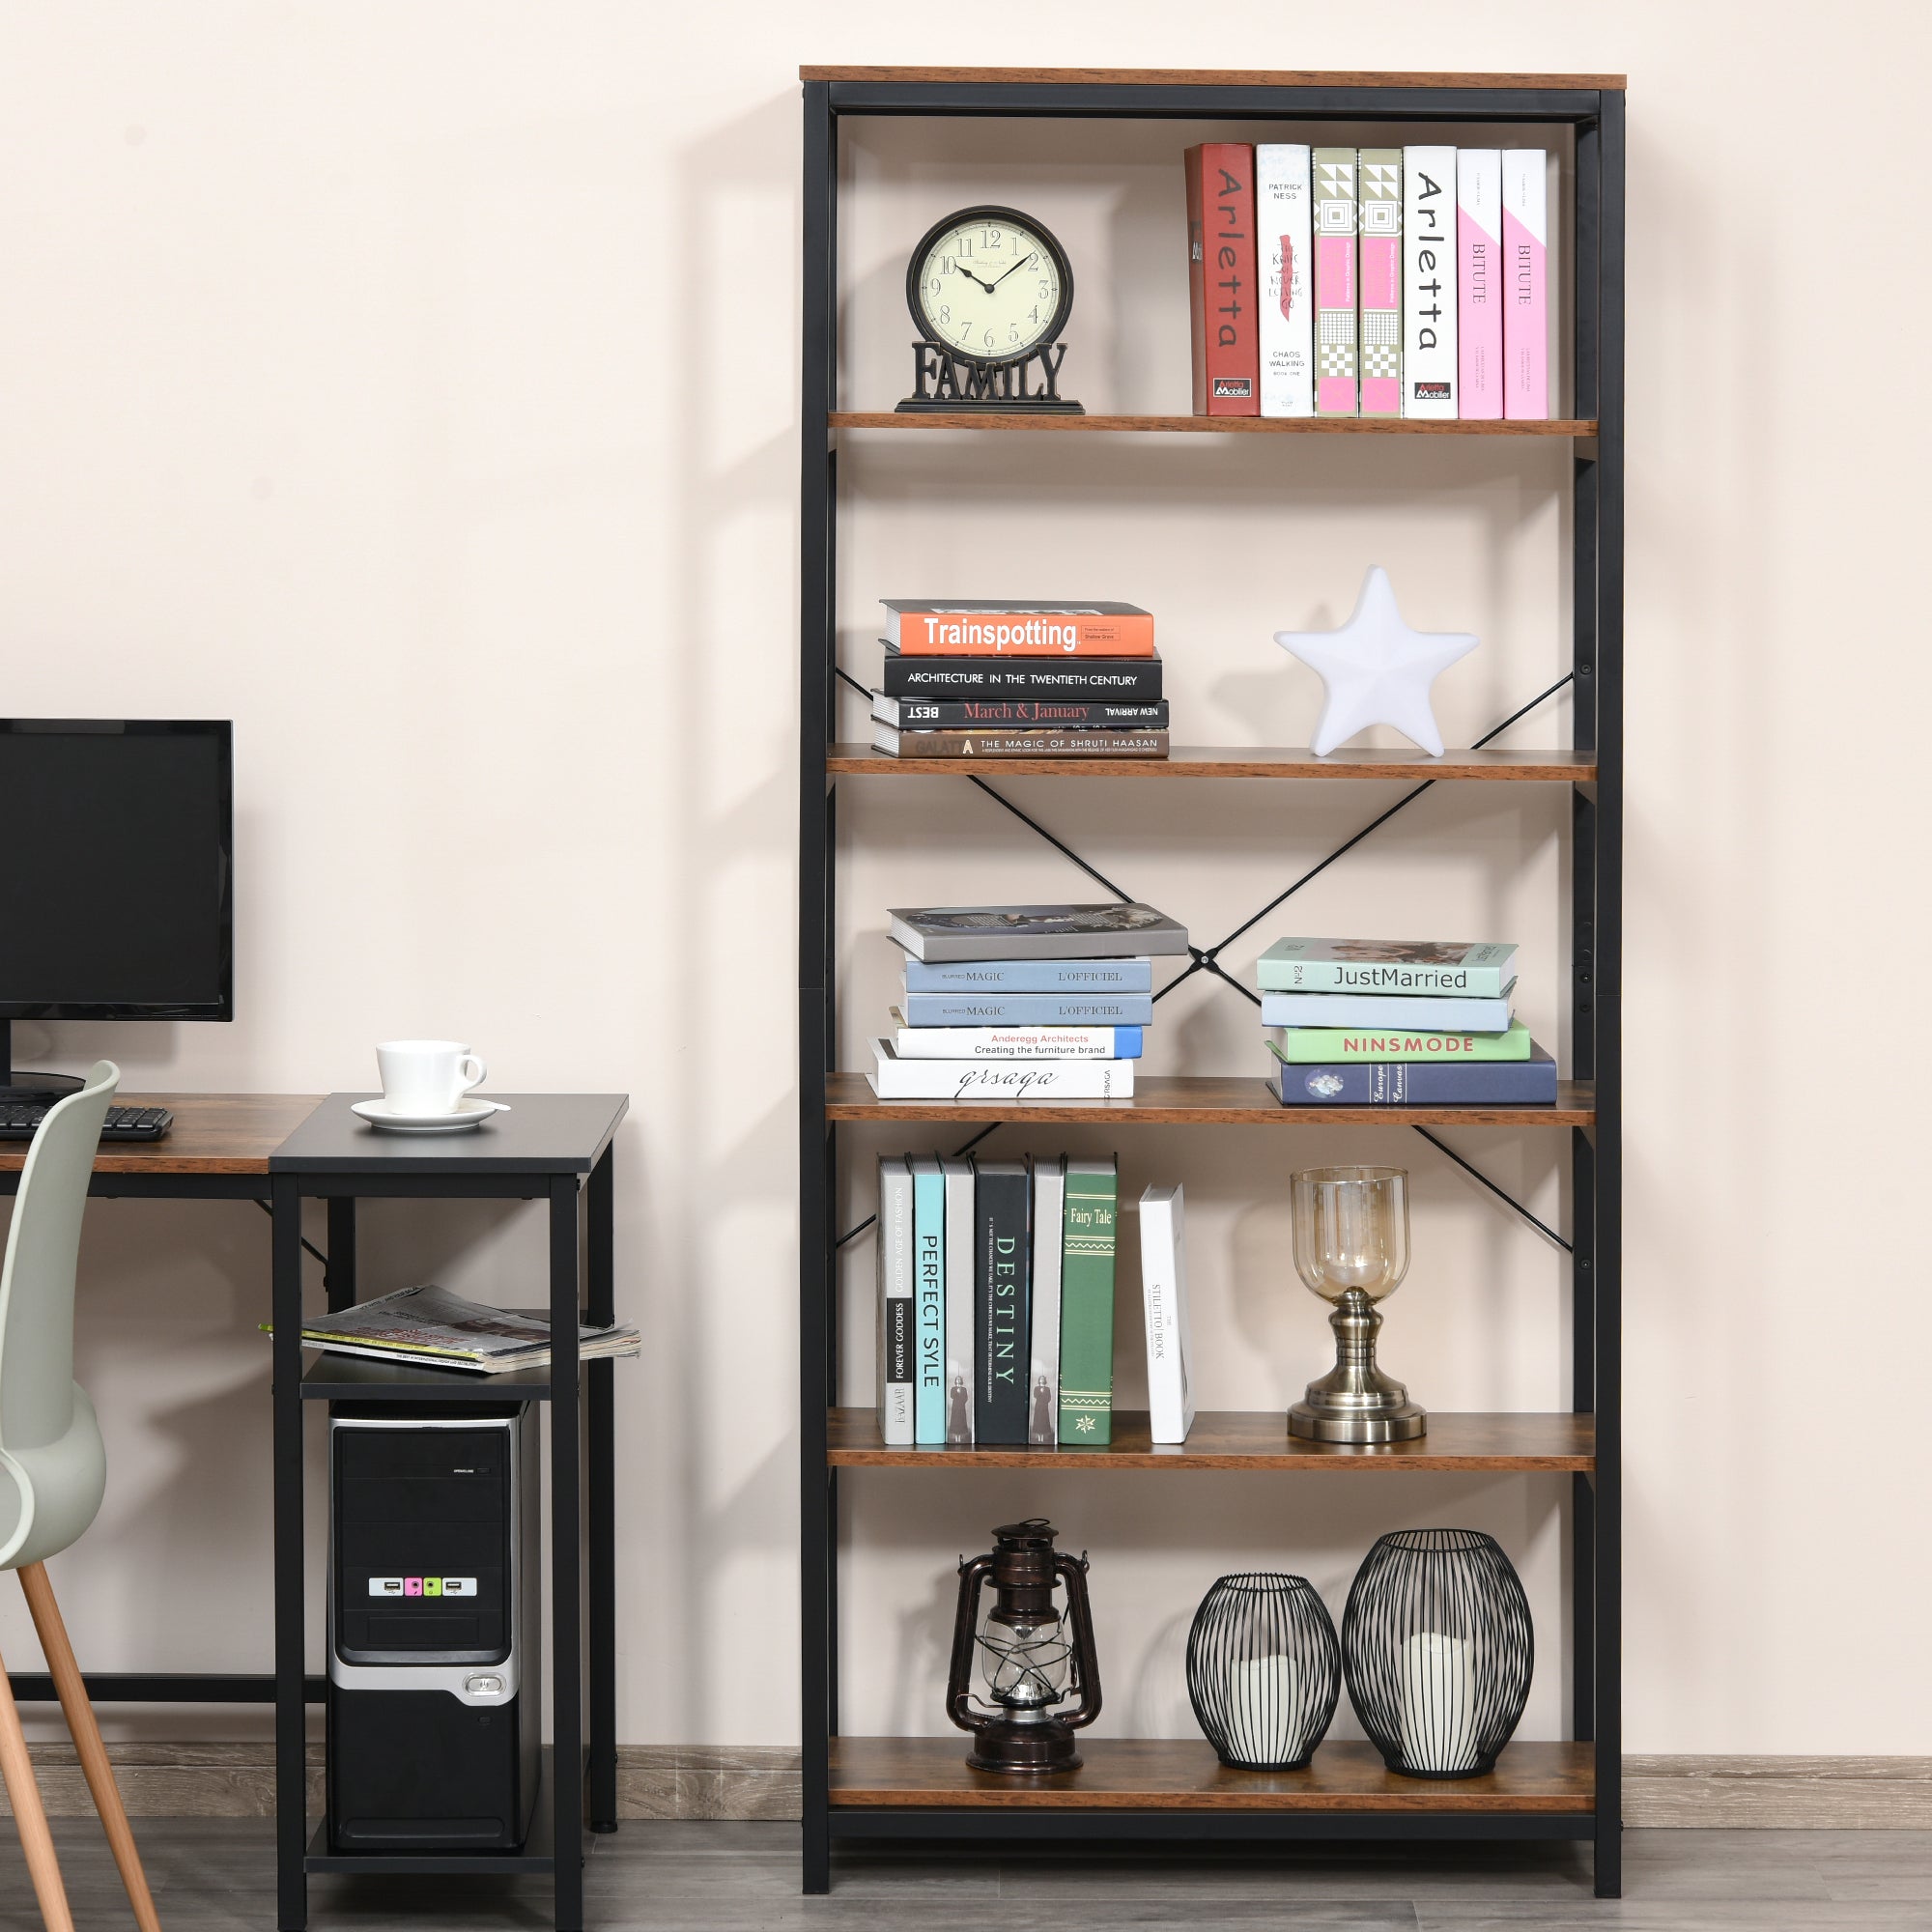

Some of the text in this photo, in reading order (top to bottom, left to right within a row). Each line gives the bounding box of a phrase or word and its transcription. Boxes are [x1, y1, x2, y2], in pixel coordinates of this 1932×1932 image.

[955, 238, 974, 258] 11
[980, 229, 1001, 249] 12
[1011, 237, 1019, 256] 1
[939, 255, 956, 275] 10
[1027, 252, 1038, 272] 2
[1218, 169, 1244, 347] Arletta
[1418, 172, 1444, 350] Arletta
[1472, 243, 1486, 304] BITUTE
[1518, 243, 1532, 305] BITUTE
[930, 277, 941, 298] 9
[1038, 279, 1049, 299] 3
[939, 304, 951, 325] 8
[1027, 304, 1038, 325] 4
[960, 322, 973, 341] 7
[983, 327, 995, 348] 6
[1009, 323, 1018, 342] 5
[912, 341, 1068, 400] FAMILY
[923, 617, 1077, 652] Trainspotting
[907, 672, 1138, 686] ARCHITECTURE IN THE TWENTIETH CENTURY
[907, 706, 939, 719] BEST
[964, 703, 1090, 722] March & January
[1105, 707, 1158, 717] NEW ARRIVAL
[1112, 739, 1157, 748] HAASAN
[966, 972, 1005, 981] MAGIC
[1058, 972, 1122, 981] L'OFFICIEL
[1333, 966, 1467, 989] JustMarried
[966, 1006, 1006, 1015] MAGIC
[1059, 1006, 1123, 1015] L'OFFICIEL
[991, 1035, 1089, 1044] Anderegg Architects
[1344, 1037, 1474, 1052] NINSMODE
[975, 1045, 1106, 1056] Creating the furniture brand
[1373, 1065, 1387, 1102] Europe
[1392, 1065, 1403, 1102] Canvas
[1070, 1208, 1112, 1227] Fairy Tale
[895, 1187, 903, 1293] GOLDEN AGE OF FASHION
[923, 1236, 940, 1387] PERFECT SYLE
[995, 1236, 1015, 1384] DESTINY
[1152, 1284, 1165, 1359] STILETTO BOOK
[895, 1302, 904, 1378] FOREVER GODDESS
